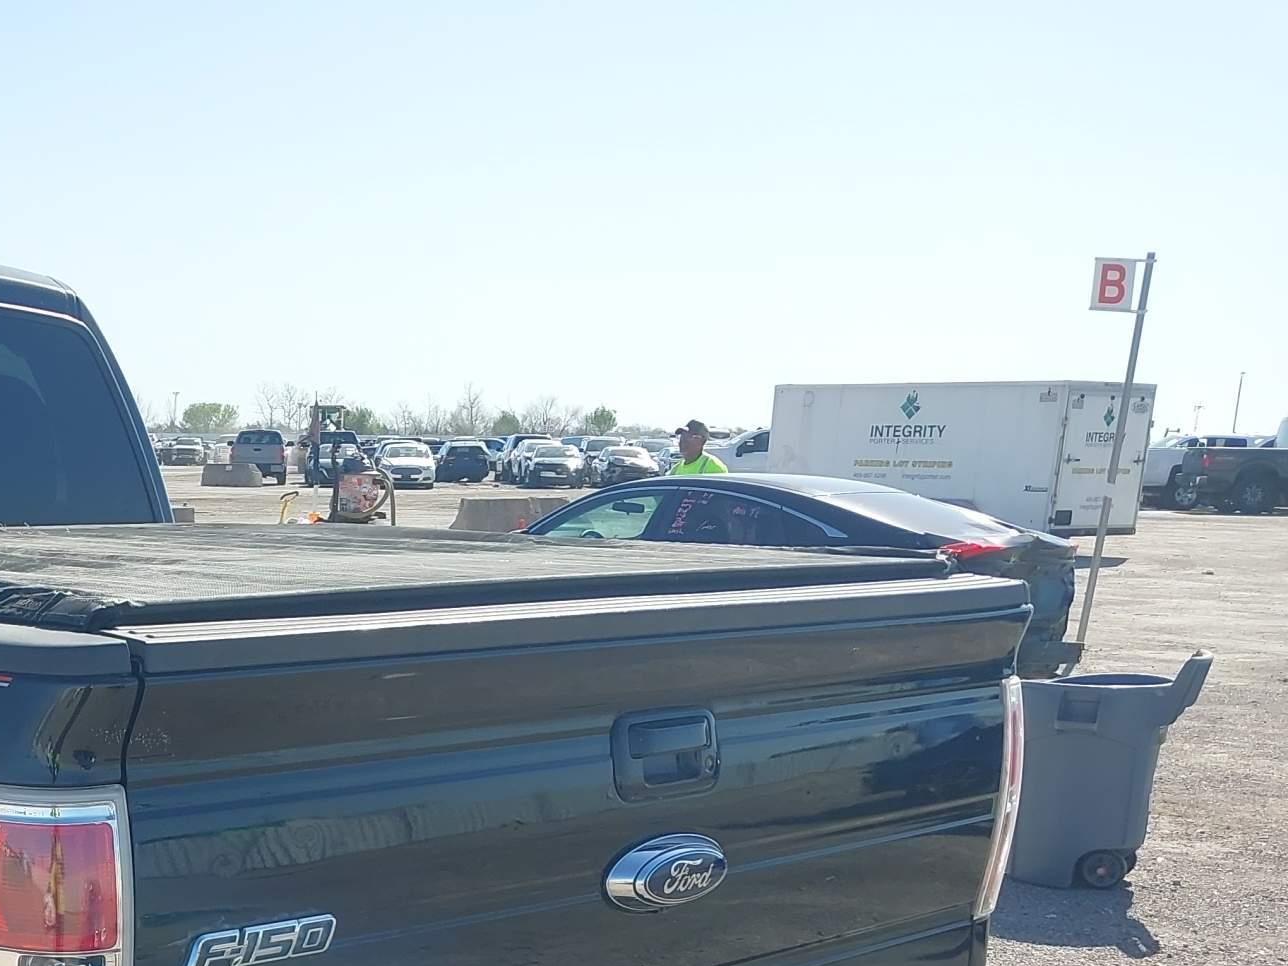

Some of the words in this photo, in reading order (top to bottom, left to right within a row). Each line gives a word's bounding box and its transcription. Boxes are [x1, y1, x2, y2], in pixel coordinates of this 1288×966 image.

[1098, 262, 1127, 305] B
[869, 424, 947, 438] INTEGRITY
[663, 857, 714, 895] Ford
